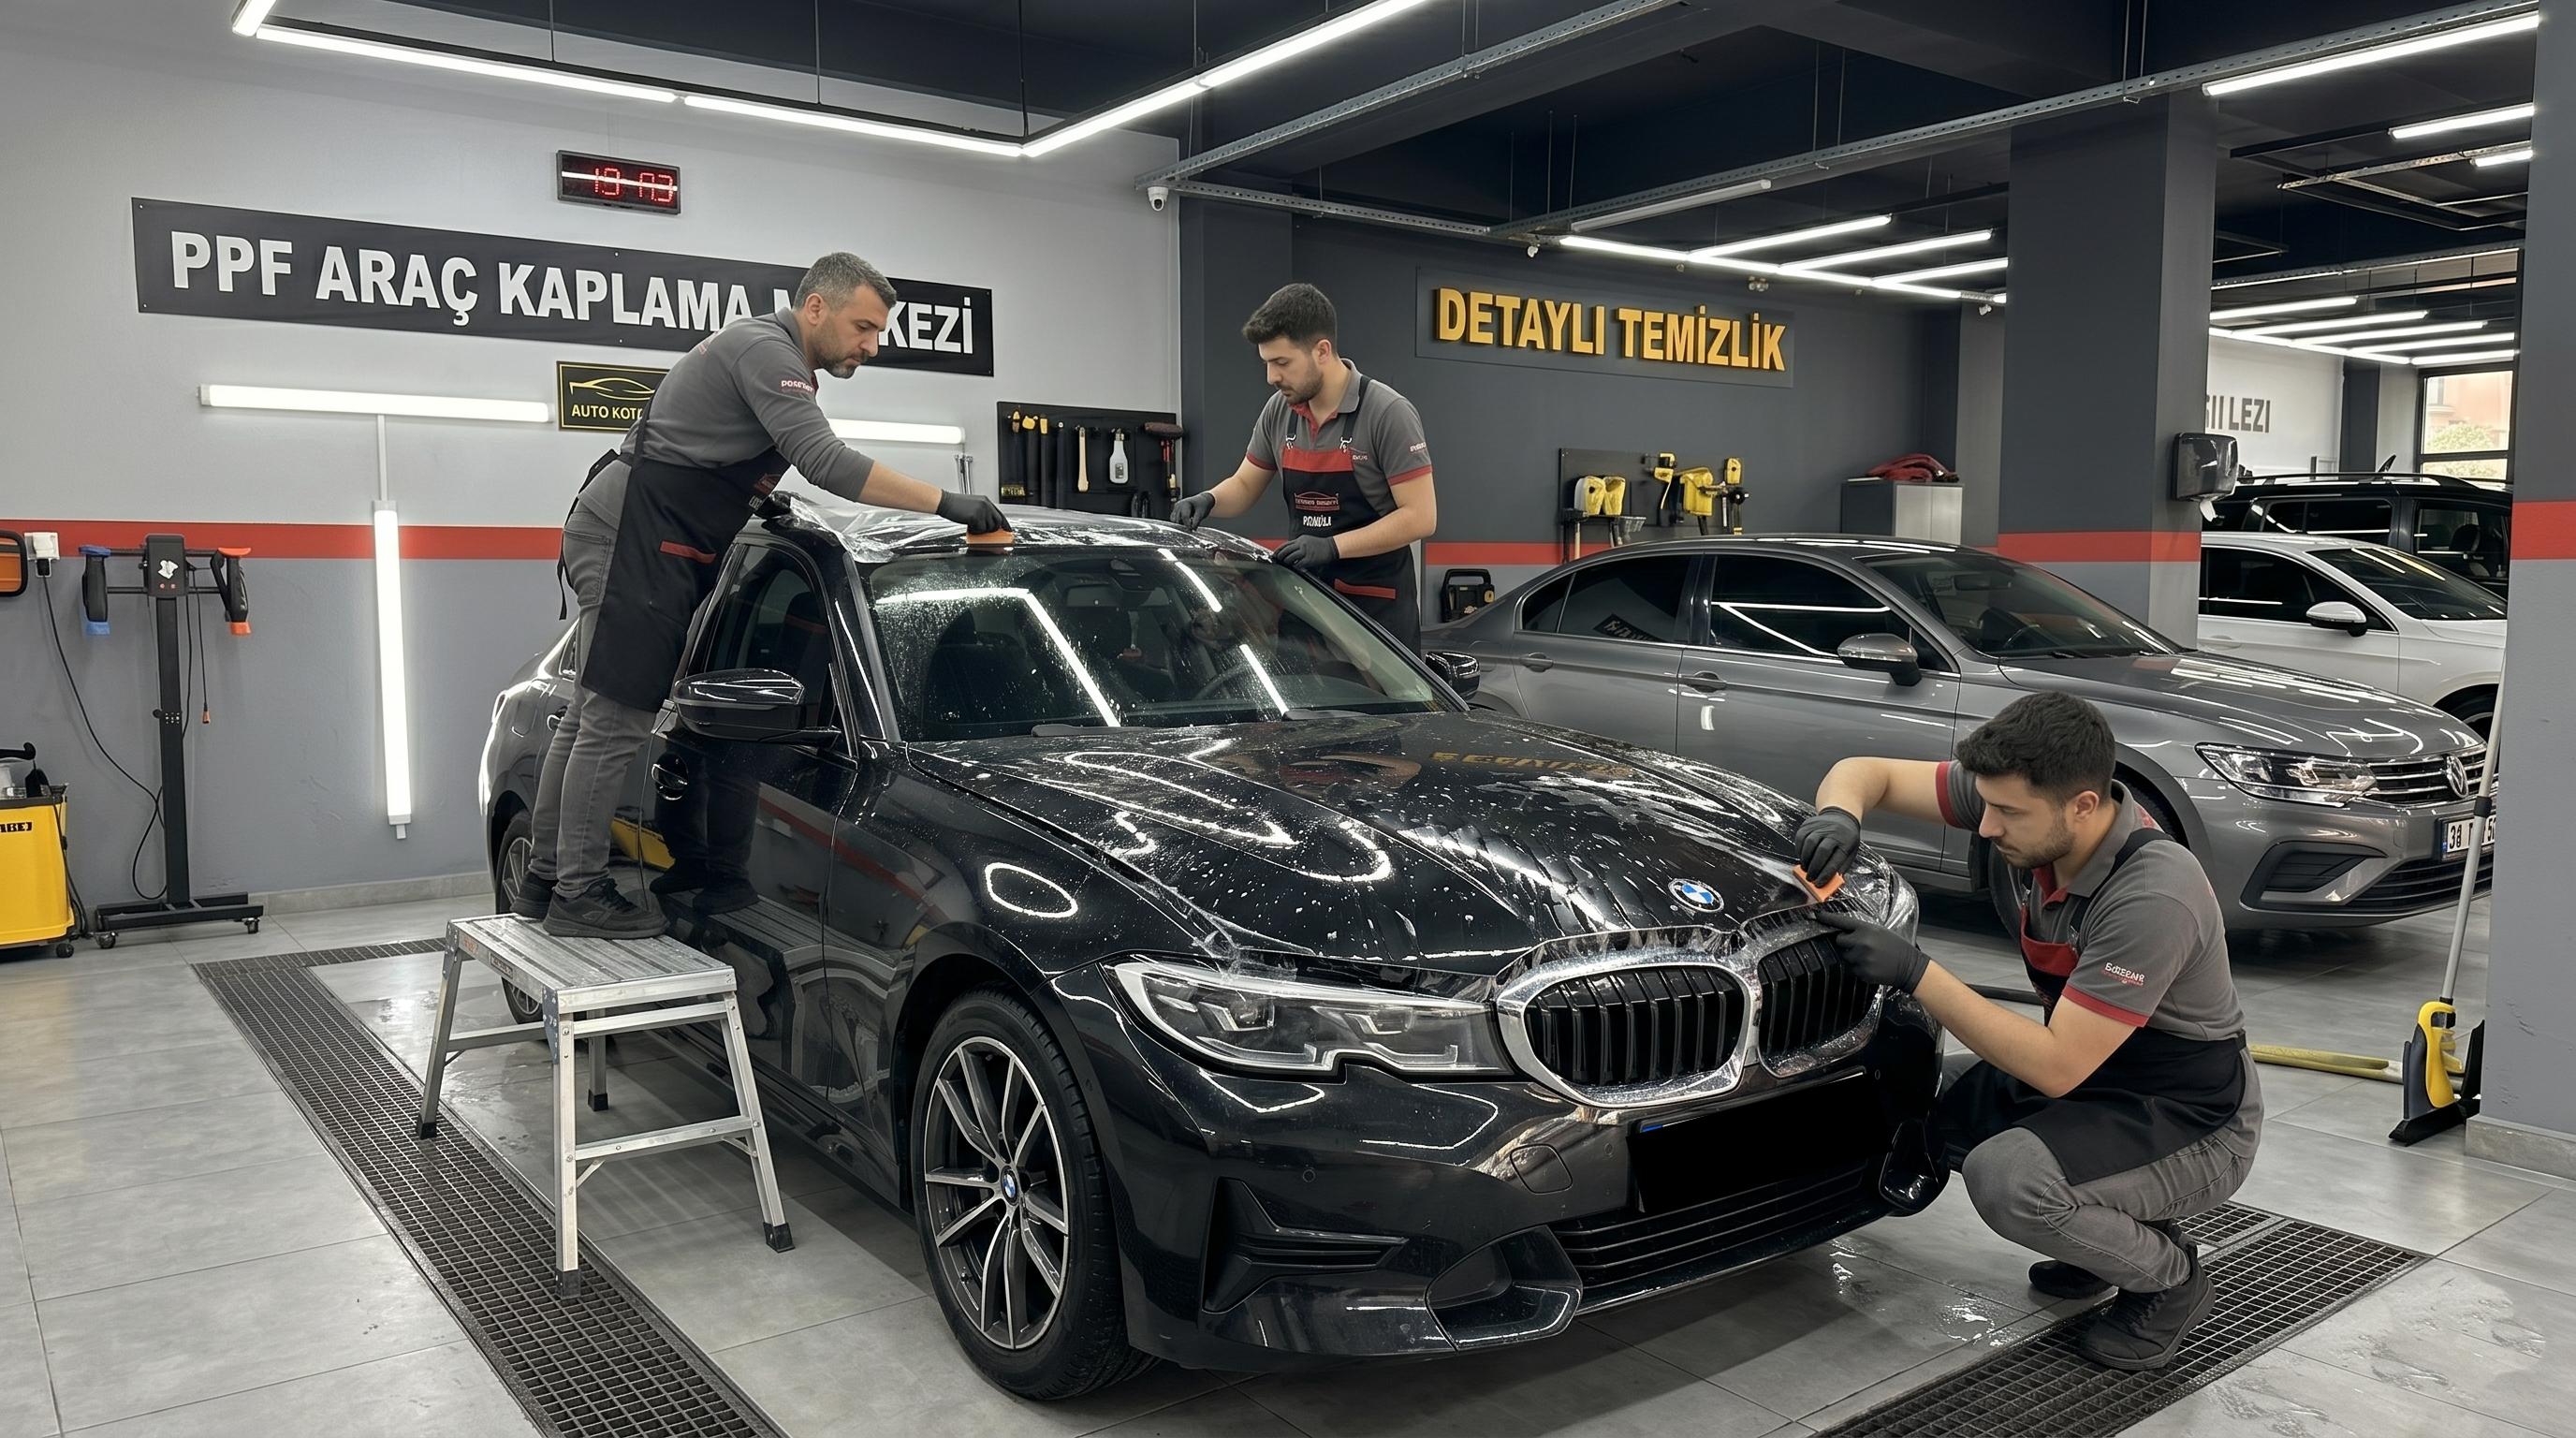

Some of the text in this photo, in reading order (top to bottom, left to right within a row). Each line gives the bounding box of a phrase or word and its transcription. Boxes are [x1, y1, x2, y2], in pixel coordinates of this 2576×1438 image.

[170, 230, 294, 297] PPF
[315, 245, 478, 326] ARAÇ
[498, 262, 753, 332] KAPLAMA
[1437, 286, 1787, 372] DETAYLI TEMİZLİK
[571, 404, 609, 418] AUTO
[2228, 396, 2271, 433] LEZI
